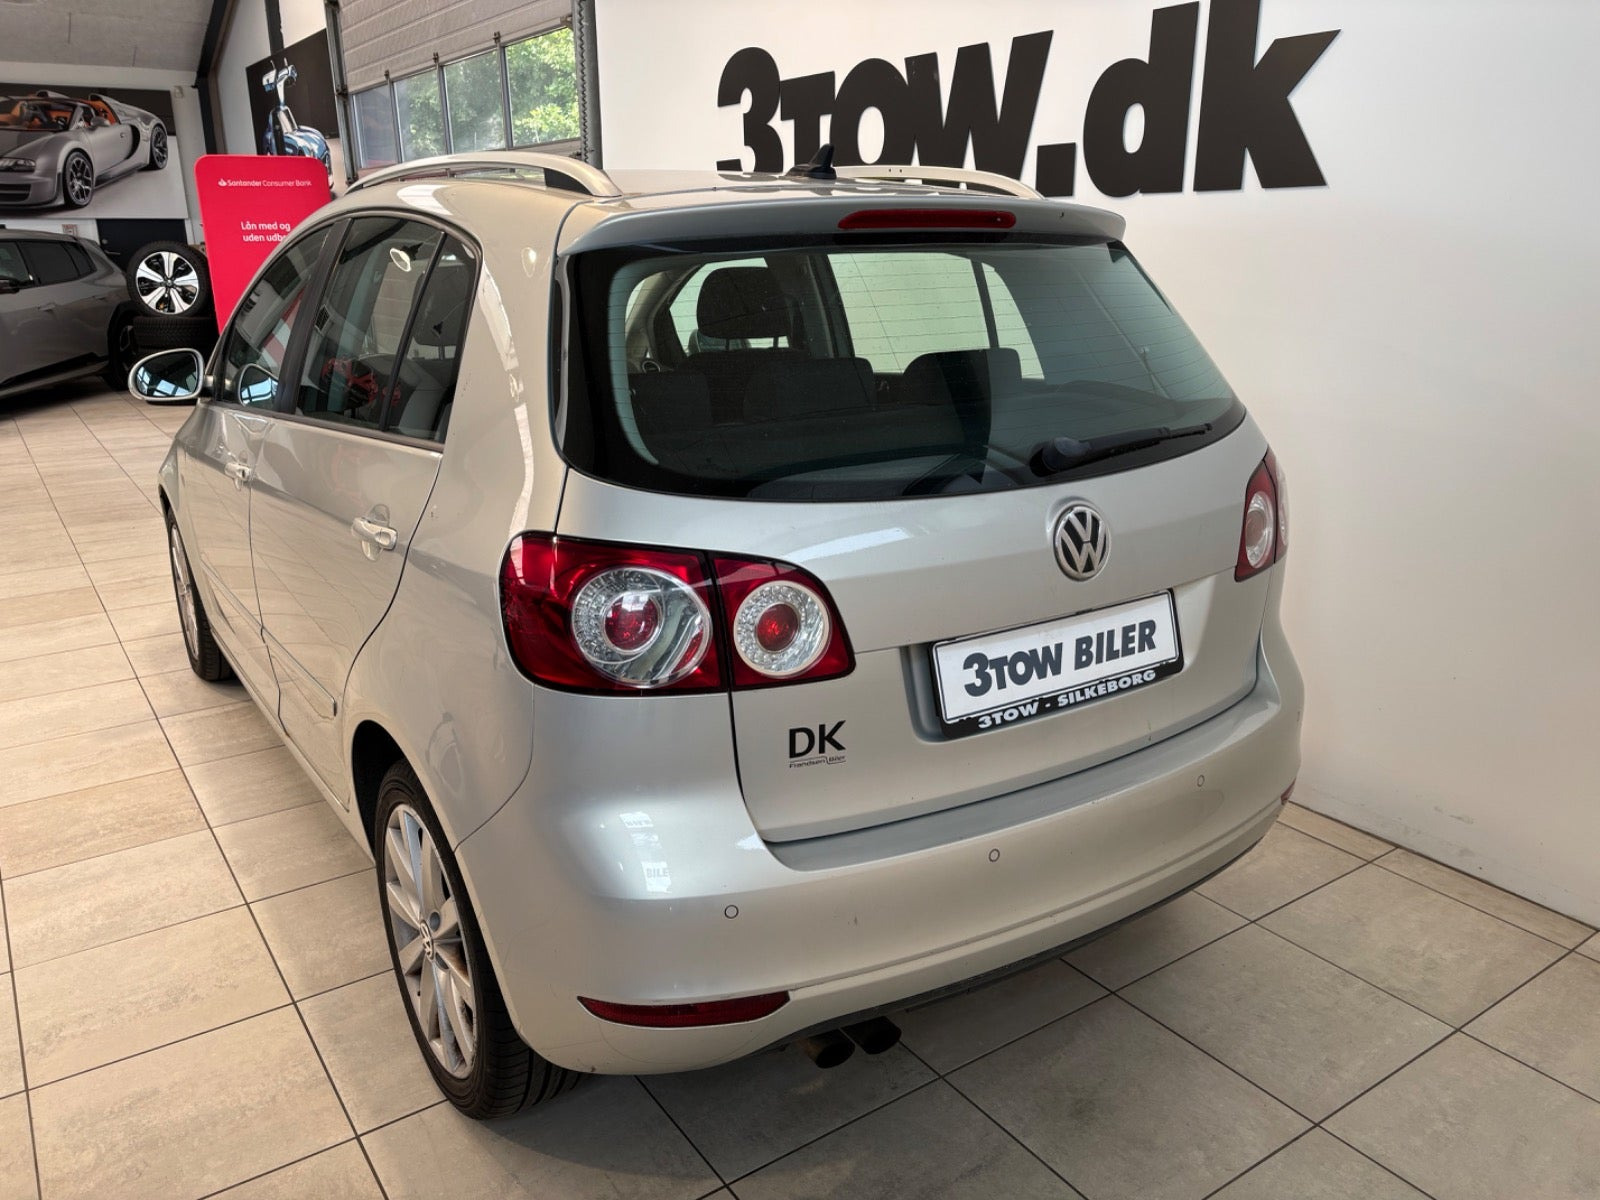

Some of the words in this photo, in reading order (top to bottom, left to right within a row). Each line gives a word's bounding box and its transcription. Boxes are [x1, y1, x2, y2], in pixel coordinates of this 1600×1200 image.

[227, 179, 262, 187] Santander
[295, 179, 312, 187] Bank
[240, 221, 257, 231] Lån
[258, 221, 278, 231] med
[279, 223, 291, 232] og
[242, 233, 265, 242] uden
[963, 642, 1063, 697] 3TOW
[1074, 619, 1156, 671] BILER
[978, 702, 1039, 729] 3TOW
[1057, 669, 1156, 708] SILKEBORG
[789, 720, 846, 759] DK
